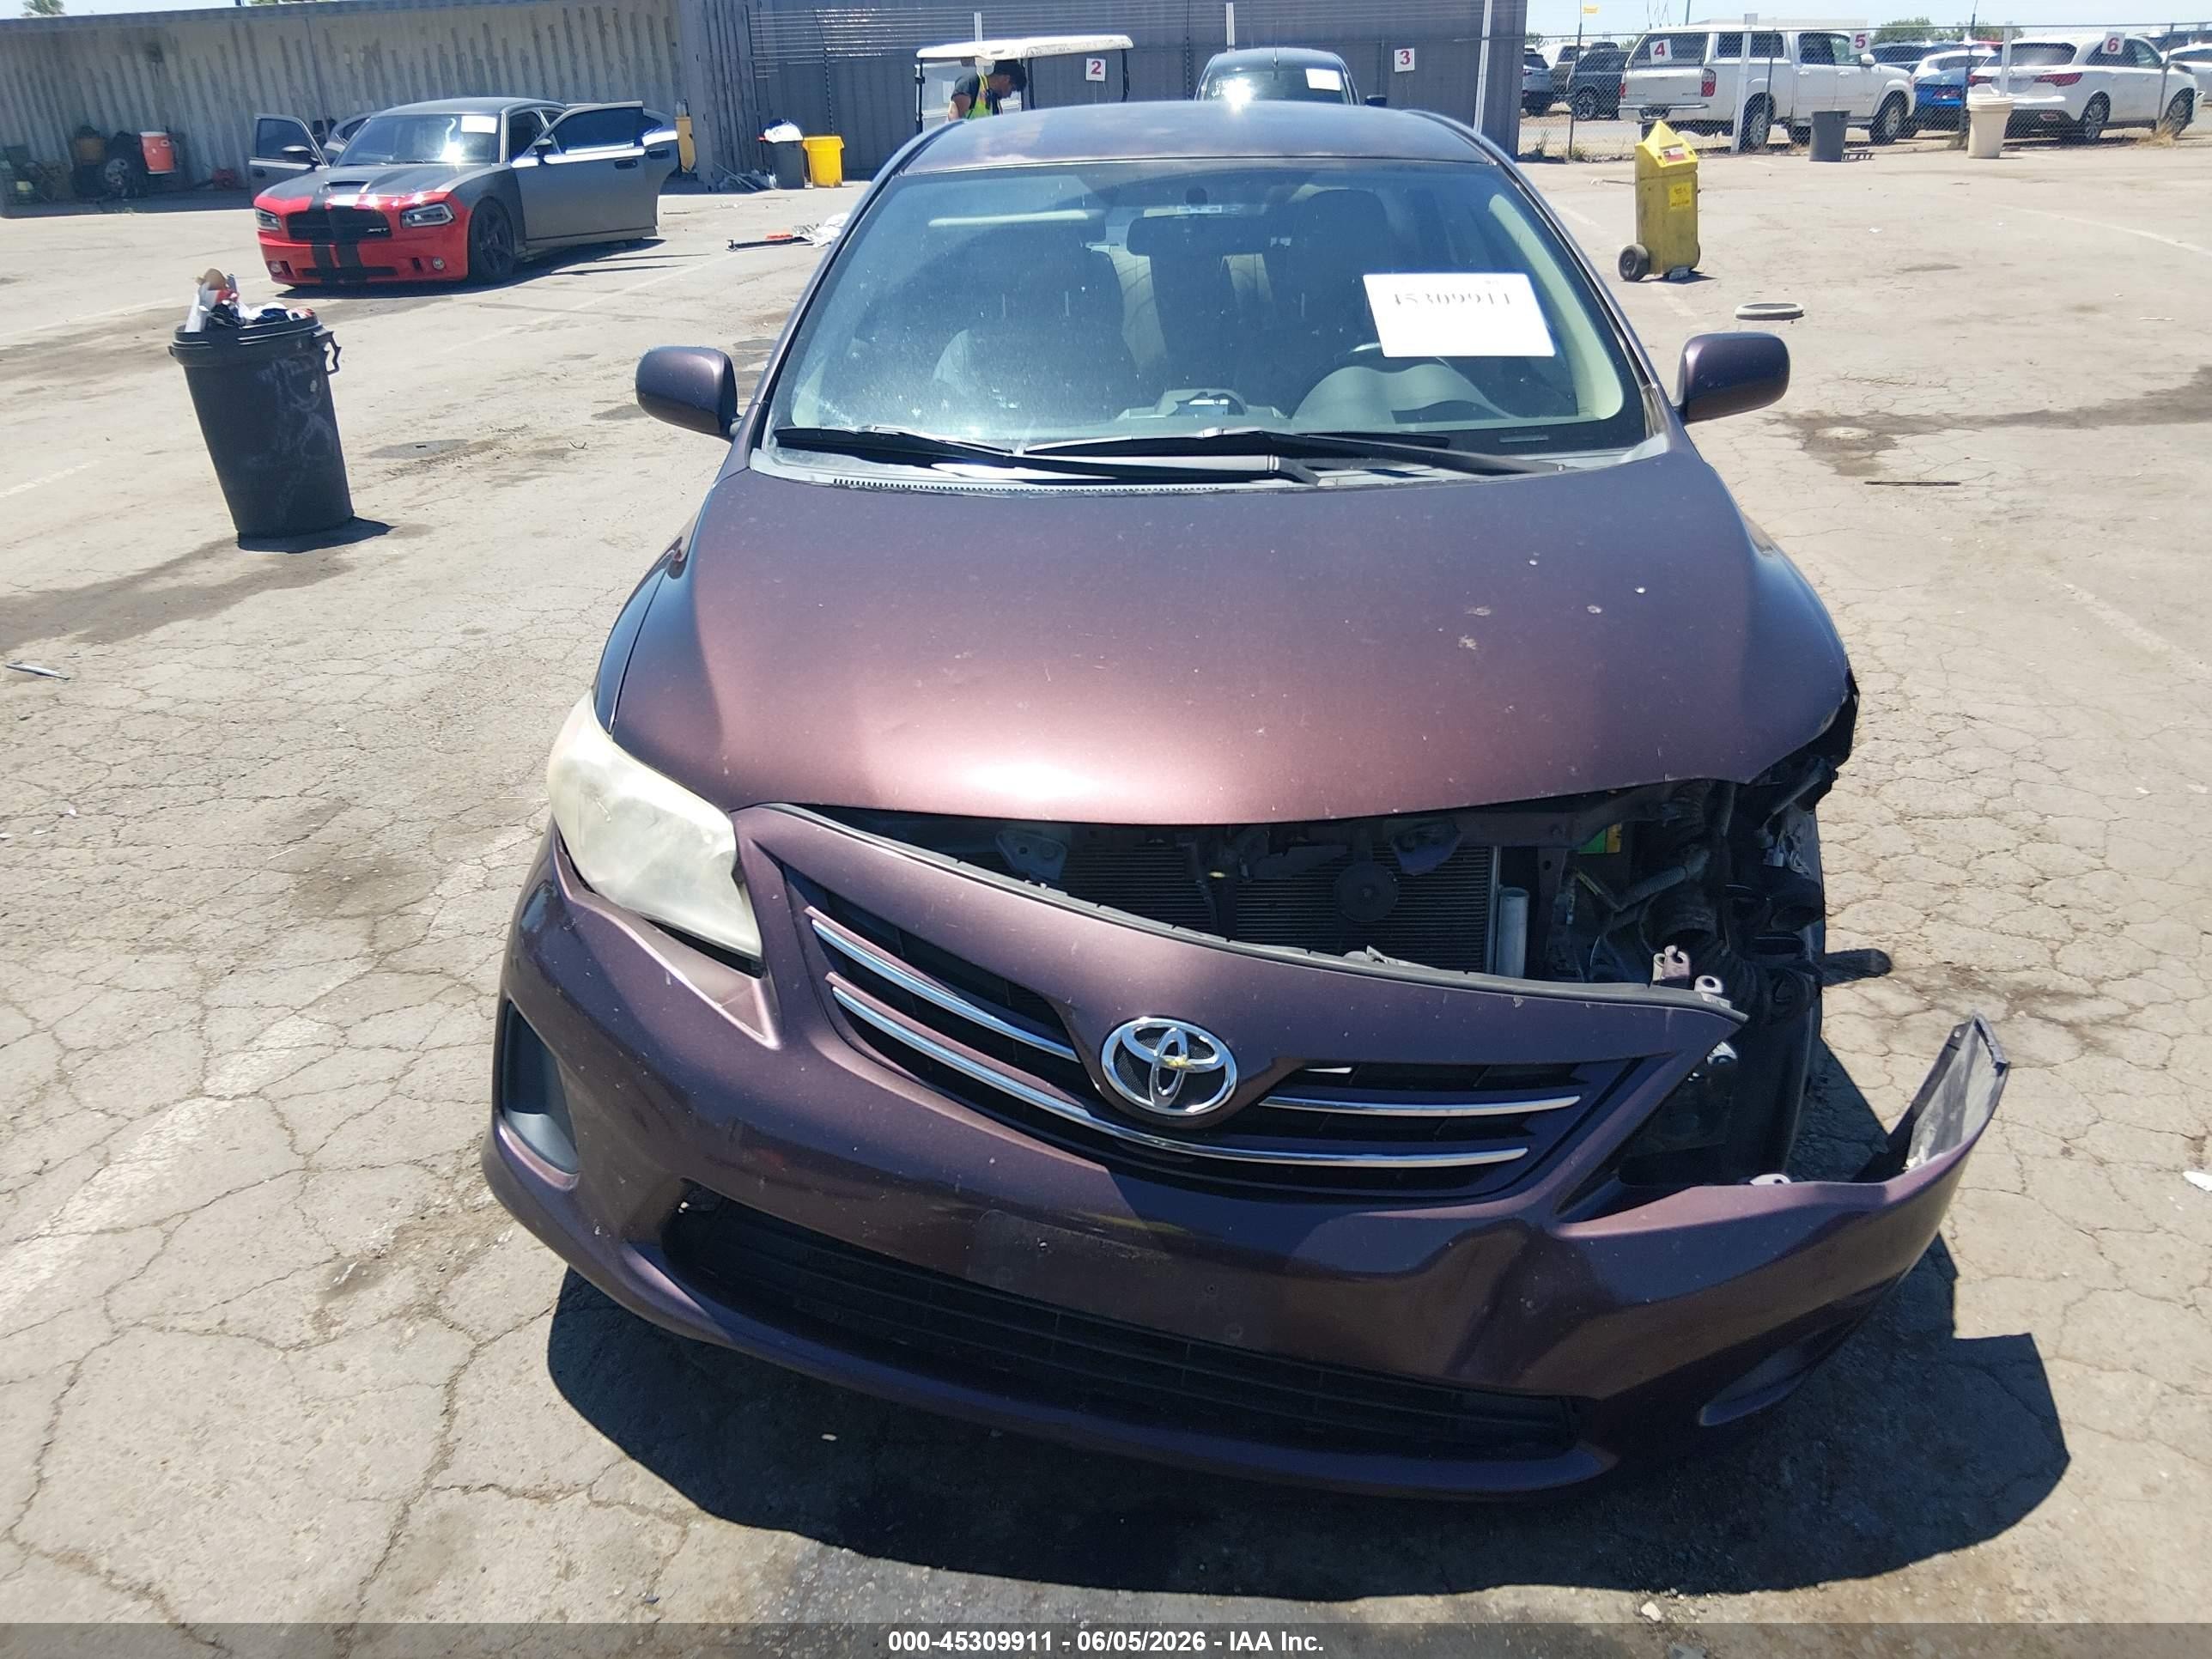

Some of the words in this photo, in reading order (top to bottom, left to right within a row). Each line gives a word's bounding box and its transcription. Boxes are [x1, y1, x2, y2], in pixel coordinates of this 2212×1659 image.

[1654, 40, 1666, 57] 4
[1854, 33, 1866, 49] 5
[2107, 37, 2119, 52] 6
[1400, 50, 1411, 65] 3
[1091, 60, 1102, 75] 2
